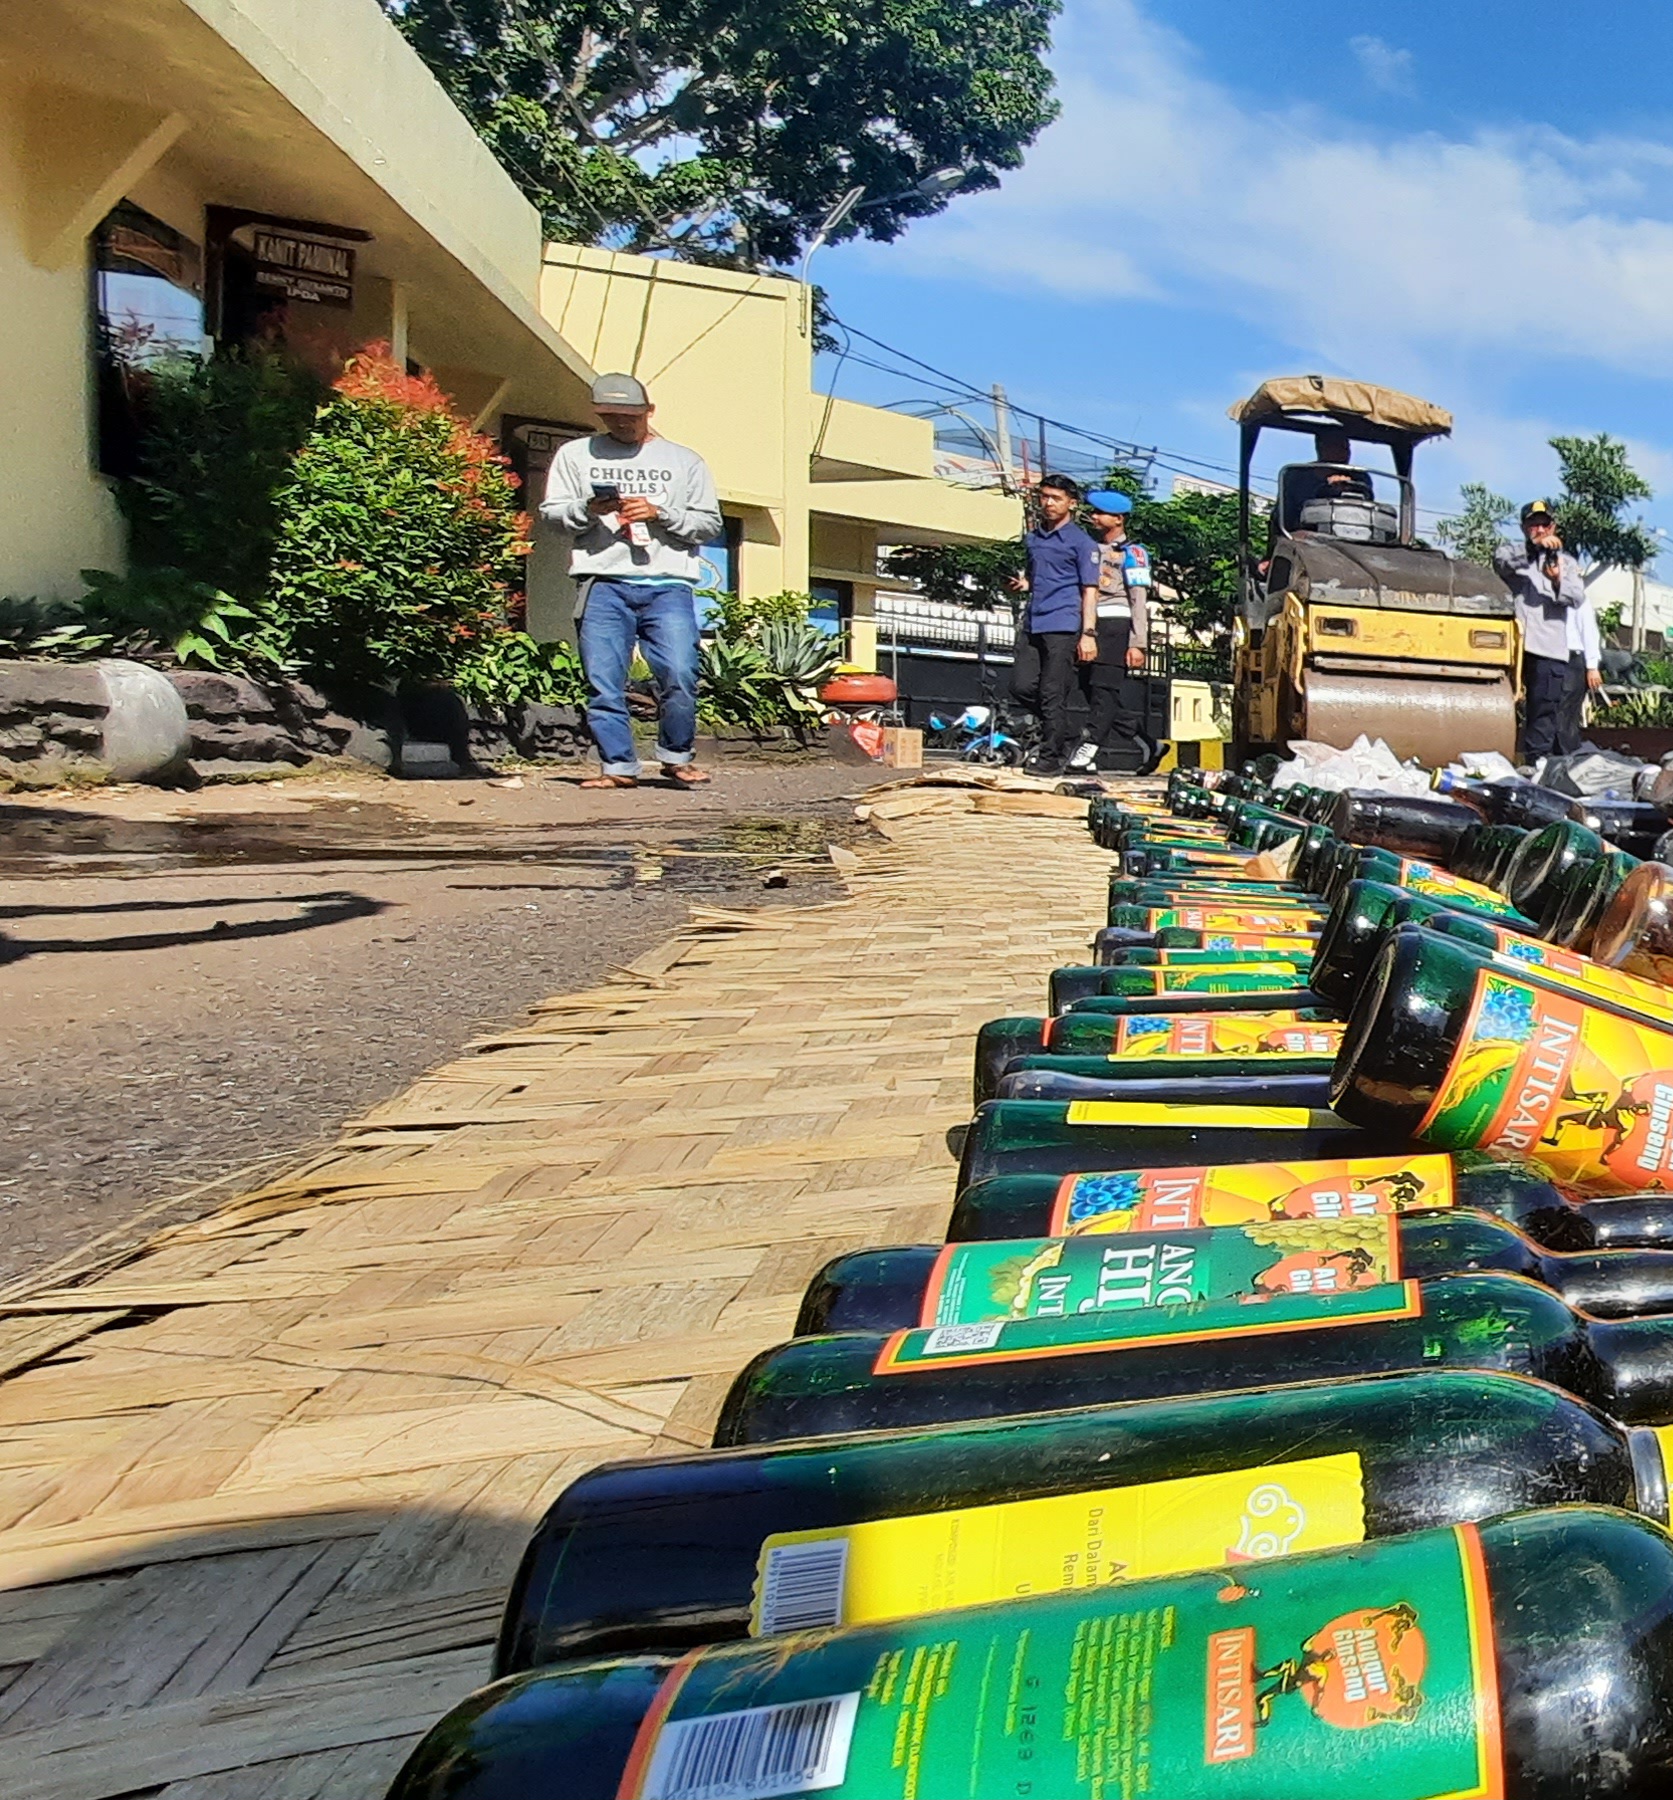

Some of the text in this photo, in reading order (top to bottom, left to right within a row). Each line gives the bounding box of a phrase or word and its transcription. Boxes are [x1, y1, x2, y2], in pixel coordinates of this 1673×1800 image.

[589, 466, 672, 482] CHICAGO
[607, 480, 657, 494] ULLS
[1492, 1013, 1580, 1152] INTISAR
[1087, 1507, 1104, 1537] Dari
[1354, 1628, 1390, 1696] Anggur
[1212, 1632, 1247, 1760] INTISARI
